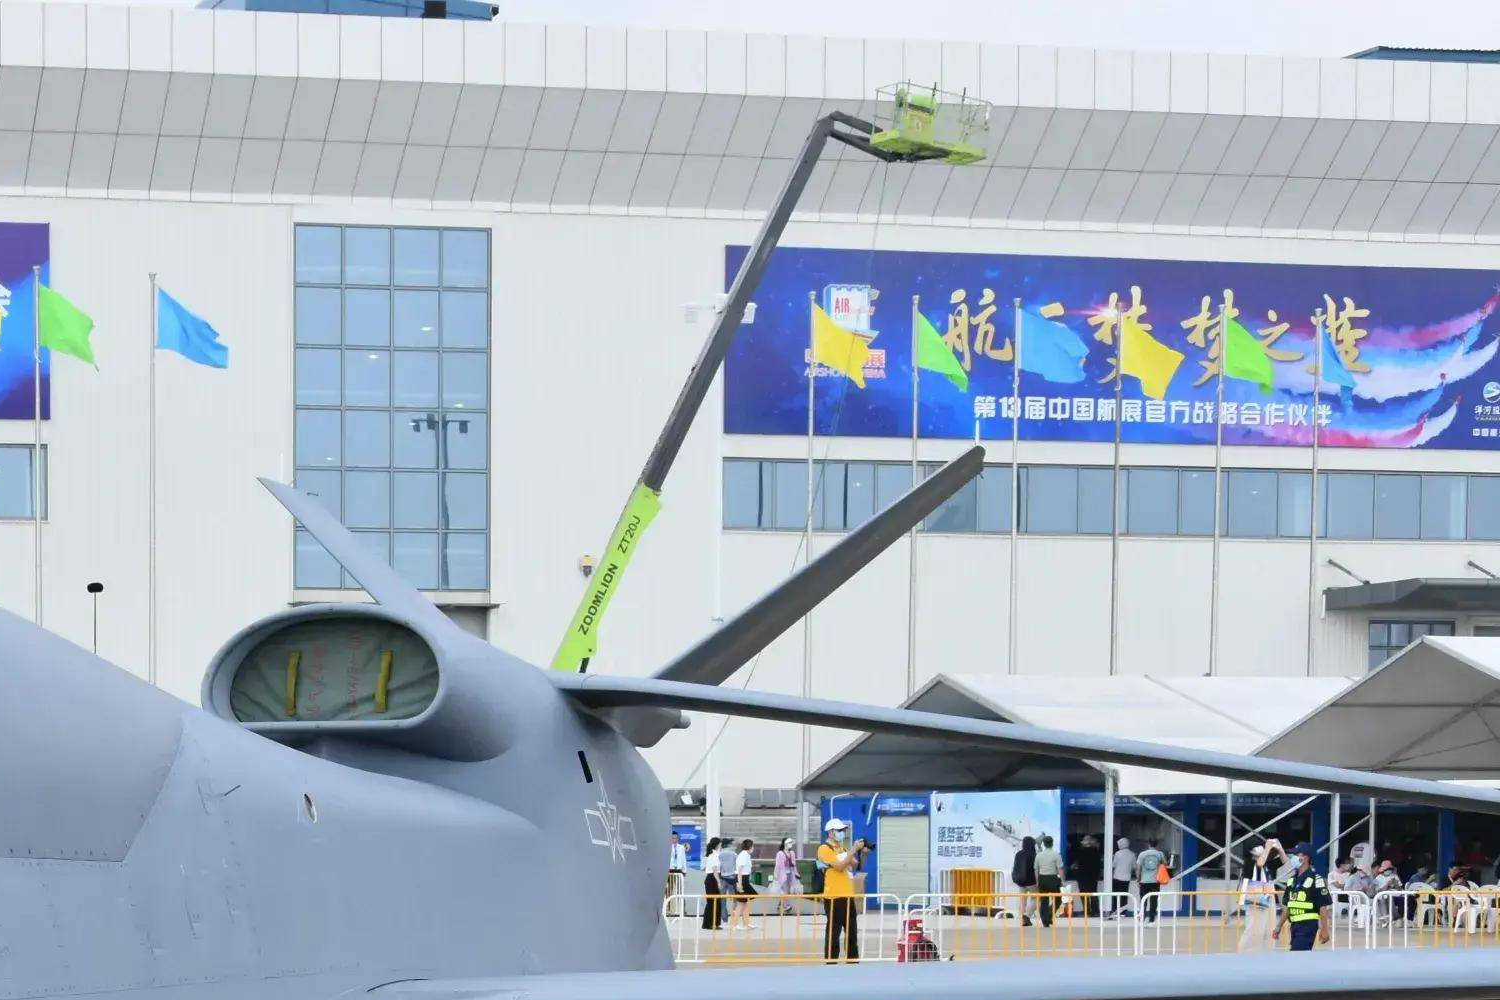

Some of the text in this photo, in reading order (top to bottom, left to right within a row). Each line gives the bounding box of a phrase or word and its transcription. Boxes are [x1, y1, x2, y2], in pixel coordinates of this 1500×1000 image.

[974, 395, 1334, 427] 第13届中国航展官方战略合作伙伴
[617, 514, 641, 554] ZT20J
[578, 562, 619, 636] ZOOMLION
